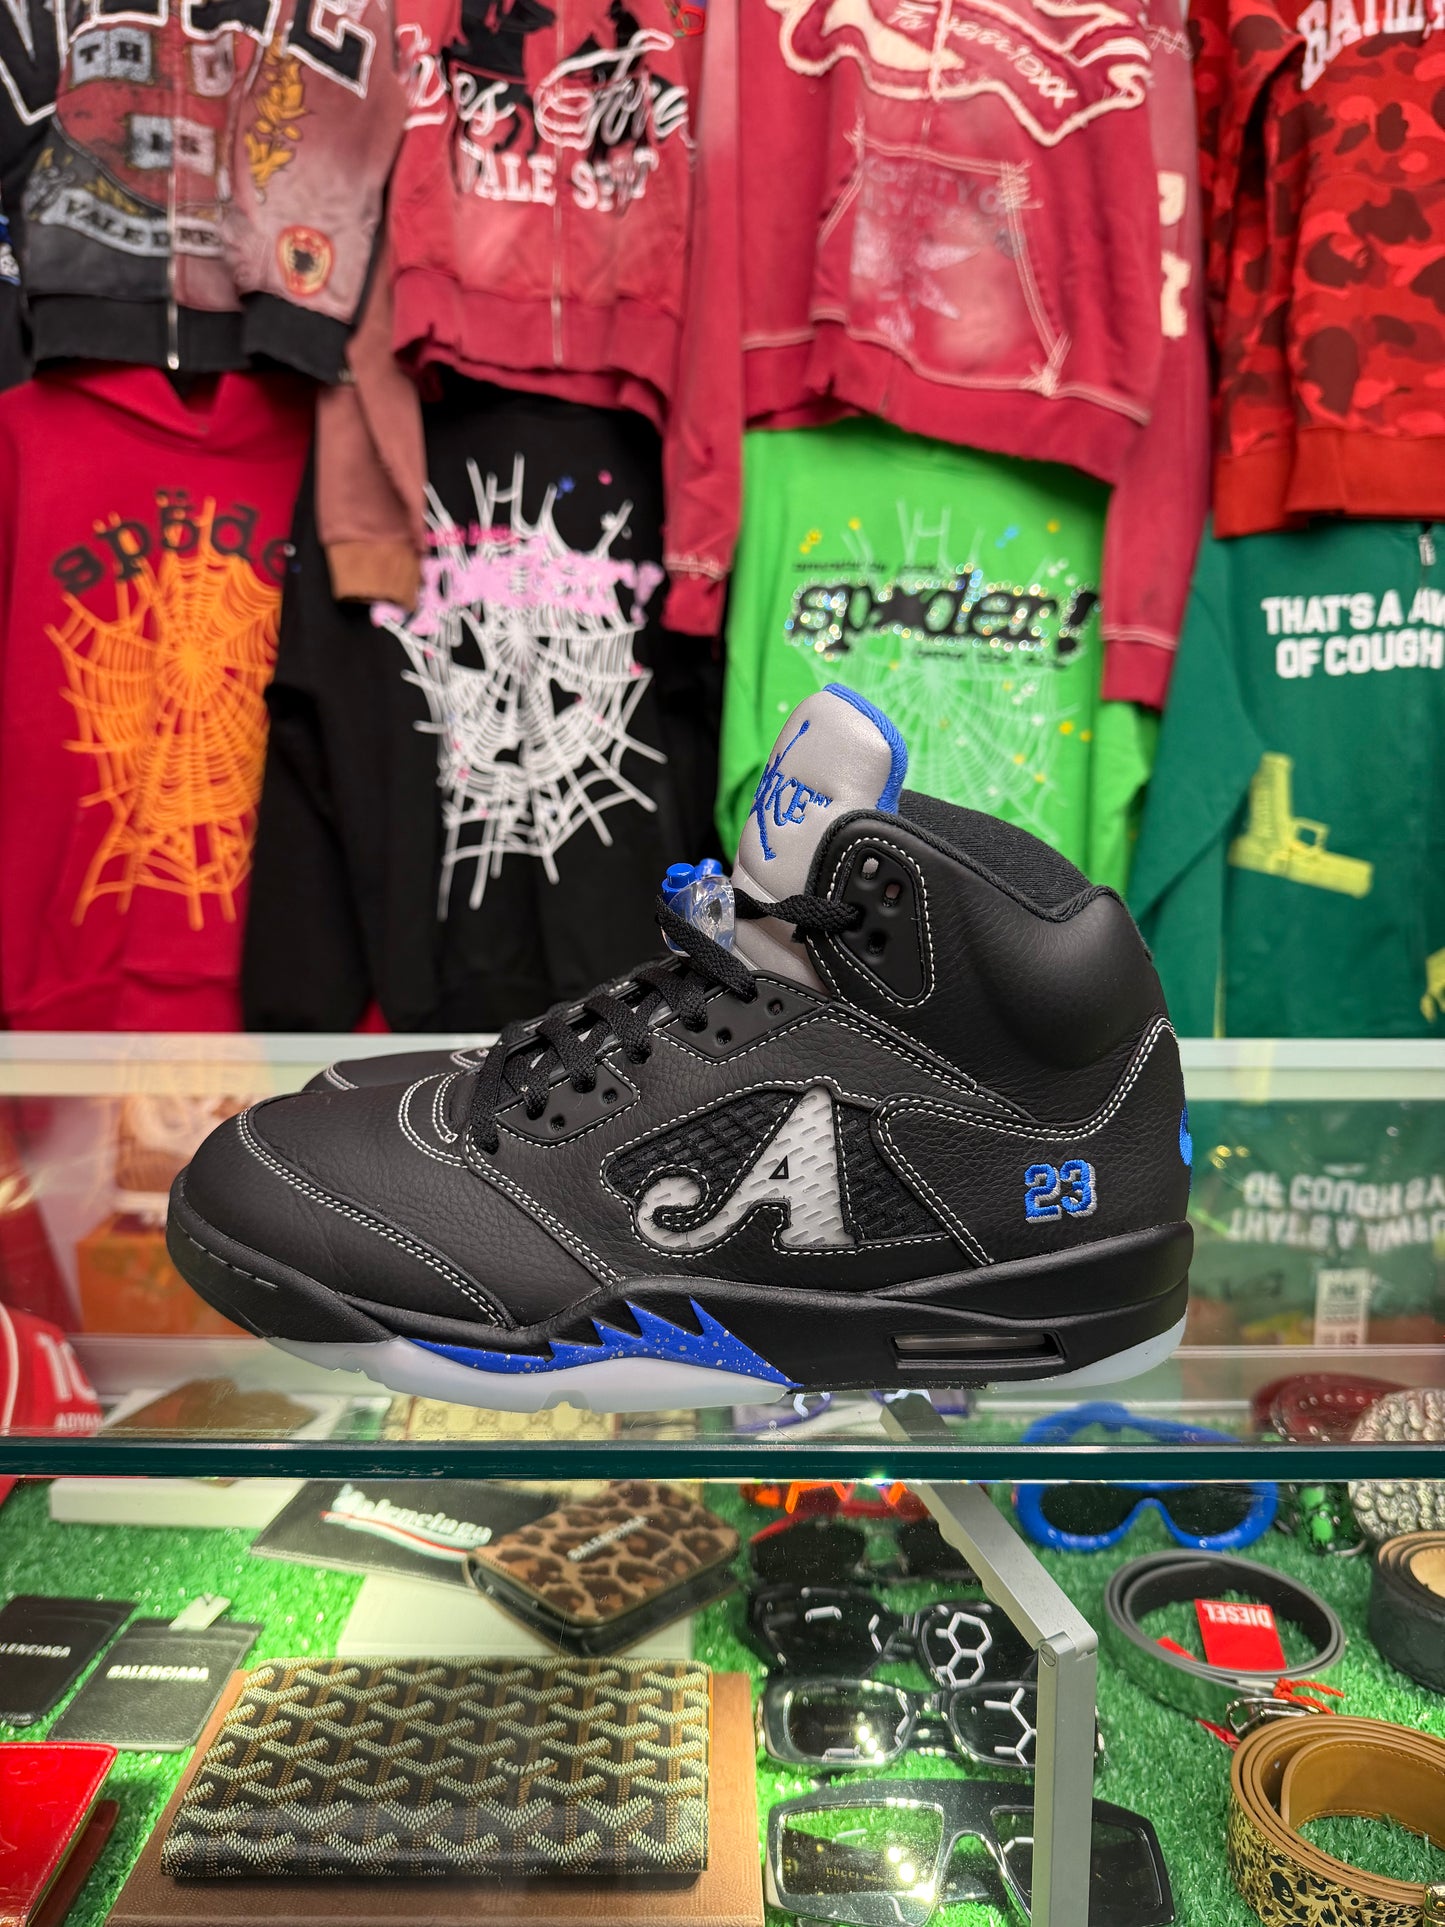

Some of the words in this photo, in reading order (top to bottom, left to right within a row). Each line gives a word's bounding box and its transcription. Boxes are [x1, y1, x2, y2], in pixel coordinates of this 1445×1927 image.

[1260, 592, 1376, 635] THAT'S
[1376, 588, 1404, 628] A
[1275, 637, 1323, 679] OF
[1324, 627, 1445, 677] COUGH
[1024, 1159, 1097, 1224] 23
[1201, 1602, 1275, 1630] DIESEL
[106, 1664, 210, 1683] BALENCIAGA
